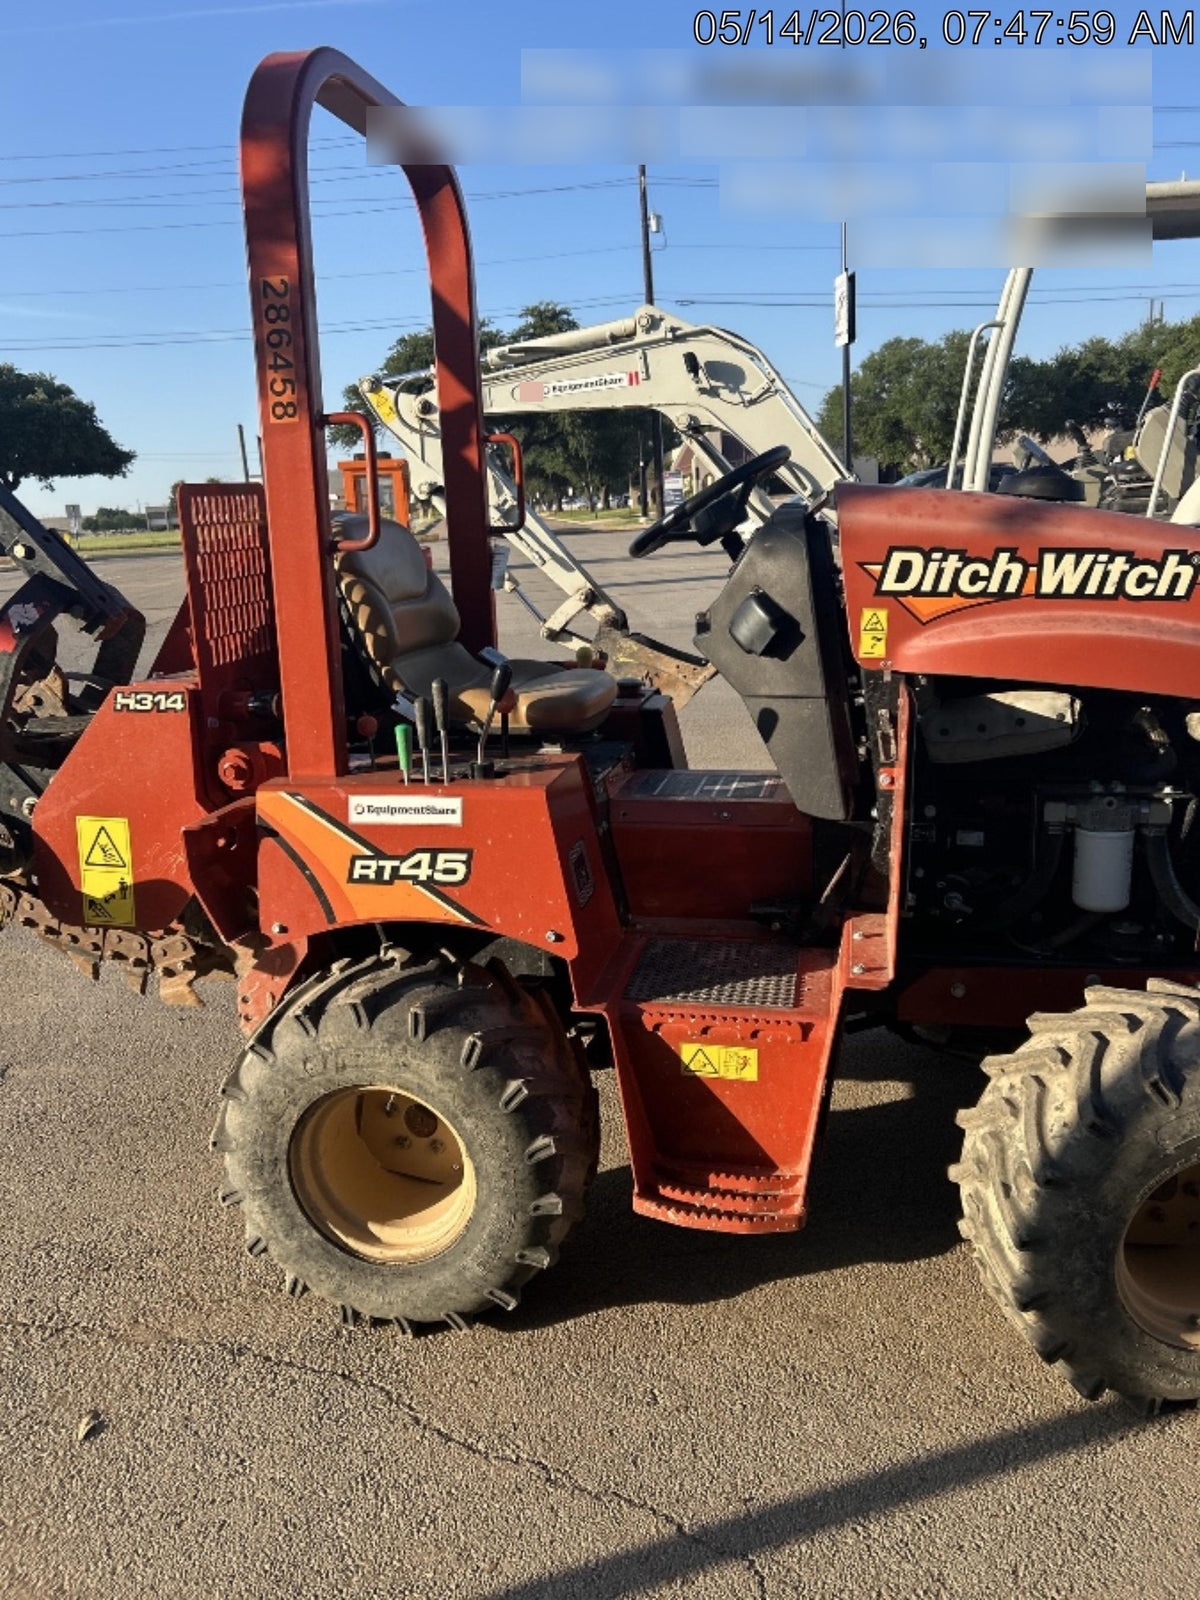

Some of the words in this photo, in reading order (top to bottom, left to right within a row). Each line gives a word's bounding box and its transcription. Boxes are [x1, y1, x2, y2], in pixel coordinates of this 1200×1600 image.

[262, 278, 298, 421] 286458
[879, 549, 1025, 594] Ditch
[1039, 551, 1196, 598] Witch
[114, 691, 186, 711] H314
[366, 804, 457, 816] EquipmentShare
[351, 852, 470, 883] RT45
